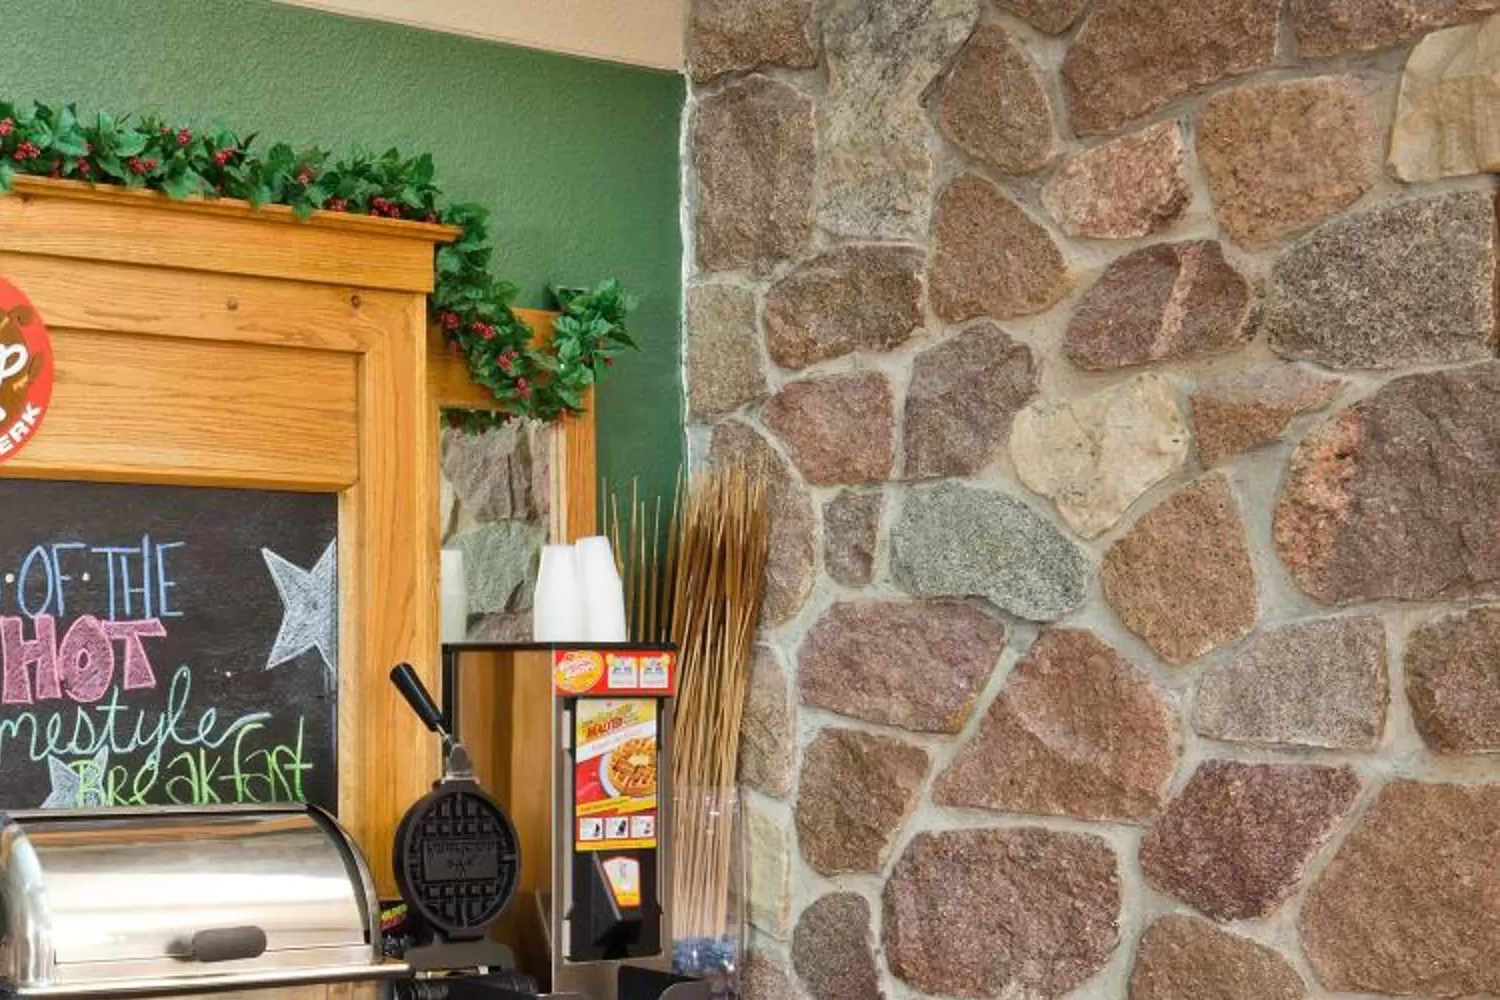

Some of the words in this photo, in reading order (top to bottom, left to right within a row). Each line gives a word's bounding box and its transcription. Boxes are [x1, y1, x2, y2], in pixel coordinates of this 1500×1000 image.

[16, 542, 87, 618] OF
[91, 533, 188, 621] THE
[0, 613, 168, 705] HOT
